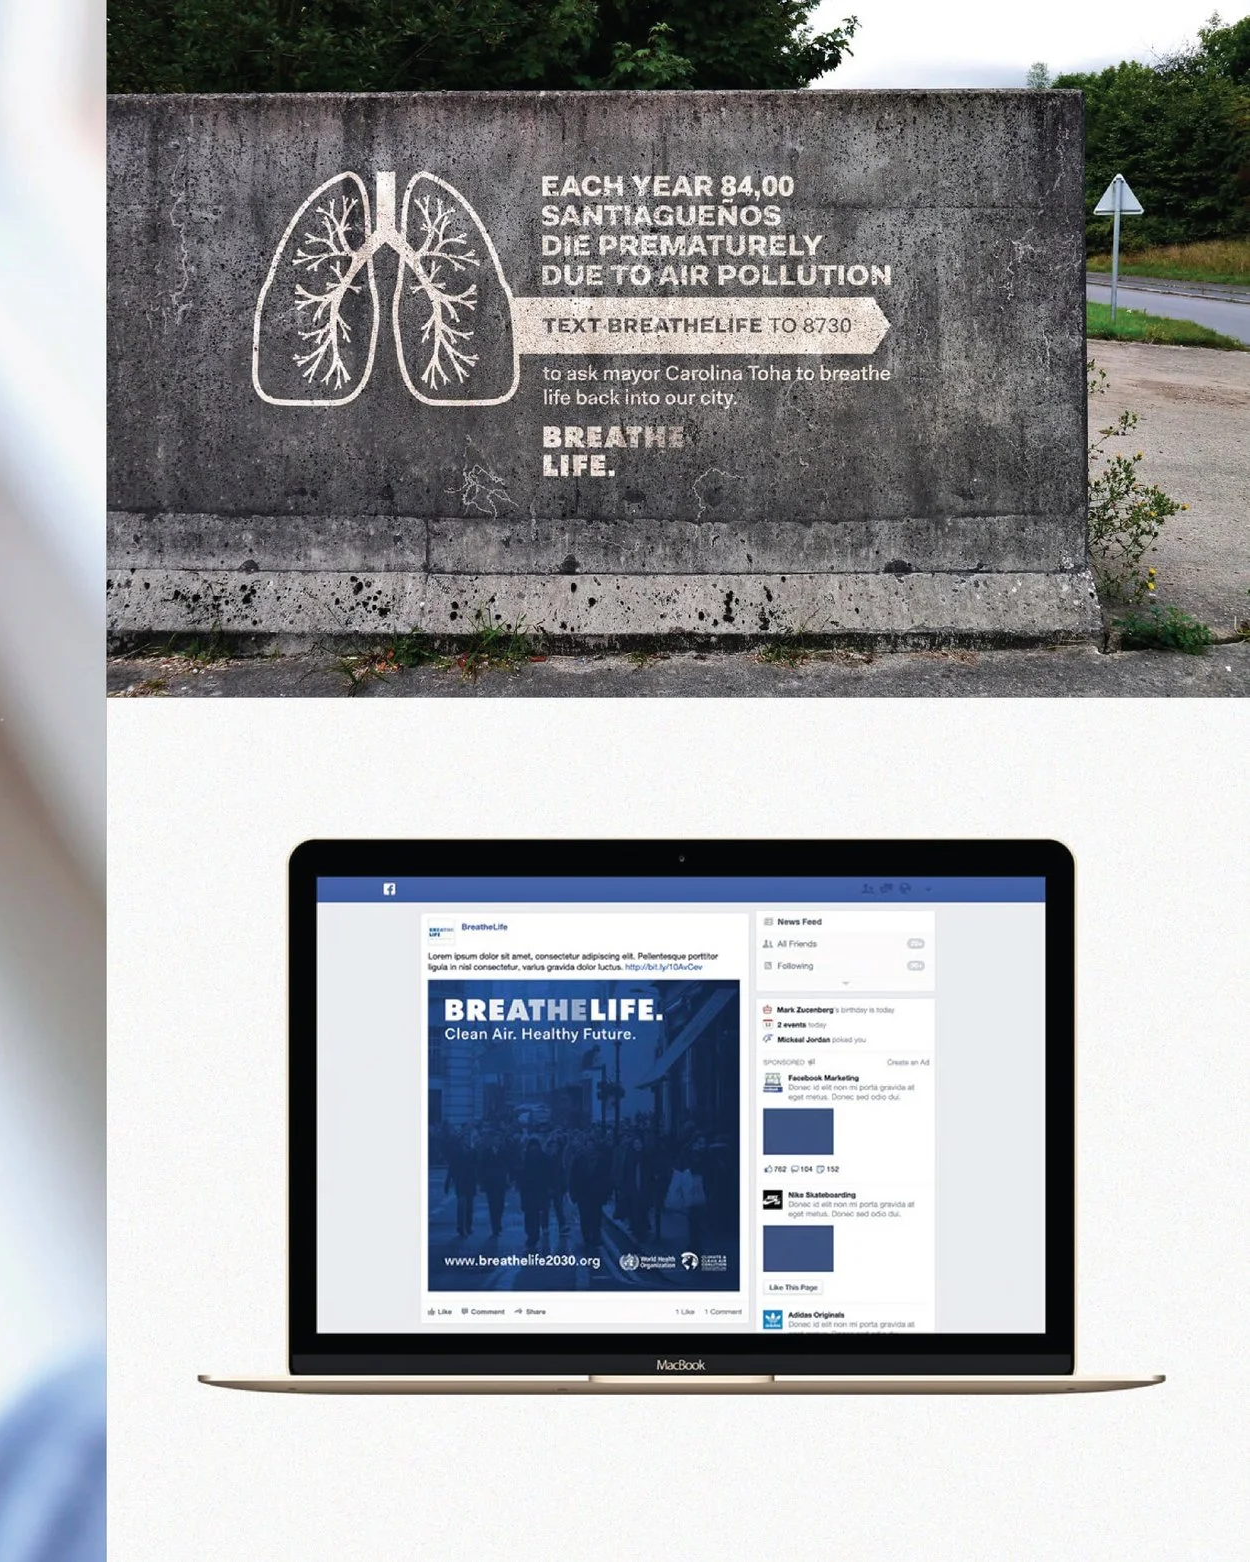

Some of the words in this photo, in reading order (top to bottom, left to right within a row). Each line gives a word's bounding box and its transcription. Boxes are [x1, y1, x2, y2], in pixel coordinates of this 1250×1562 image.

[542, 175, 624, 197] EACH
[632, 175, 713, 197] YEAR
[721, 175, 794, 201] 84,00
[542, 199, 782, 226] SANTIAGUEÑOS
[542, 235, 591, 257] DIE
[599, 235, 823, 257] PREMATURELY
[542, 265, 603, 286] DUE
[611, 265, 651, 286] TO
[659, 265, 709, 286] AIR
[718, 265, 892, 286] POLLUTION
[543, 318, 605, 333] TEXT
[608, 317, 762, 333] BREATHELIFE
[768, 318, 797, 333] TO
[803, 318, 853, 333] 8730
[543, 367, 562, 381] to
[567, 365, 597, 381] ask
[603, 369, 661, 385] mayor
[665, 365, 743, 381] Carolina
[748, 365, 791, 381] Toha
[797, 367, 815, 381] to
[820, 365, 892, 381] breathe
[543, 389, 571, 405] life
[576, 389, 619, 405] back
[625, 389, 660, 405] into
[665, 393, 694, 405] our
[700, 390, 737, 409] city.
[543, 426, 685, 448] BREATHE
[543, 454, 615, 477] LIFE.
[462, 923, 508, 931] BreatheLife
[789, 940, 817, 948] Friends
[454, 953, 478, 962] ipsum
[512, 953, 534, 961] amet,
[582, 952, 620, 962] adipiscing
[622, 952, 636, 960] elit.
[638, 952, 687, 962] Pellentesque
[688, 953, 719, 962] porttitor
[428, 963, 448, 973] ligula
[450, 963, 457, 971] in
[458, 963, 472, 971] nisl
[473, 963, 521, 972] consectetur,
[522, 963, 546, 971] varius
[546, 963, 575, 973] gravida
[576, 963, 597, 971] dolor
[598, 963, 624, 971] luctus.
[625, 963, 703, 972] http://bit.ly/10AvCev
[778, 962, 814, 971] Following
[445, 999, 663, 1021] BREATHELIFE.
[445, 1028, 487, 1039] Clean
[493, 1028, 516, 1039] Air.
[522, 1028, 578, 1042] Healthy
[584, 1028, 635, 1039] Future.
[445, 1254, 600, 1269] www.breathelife2030.org
[657, 1359, 706, 1370] MacBook
